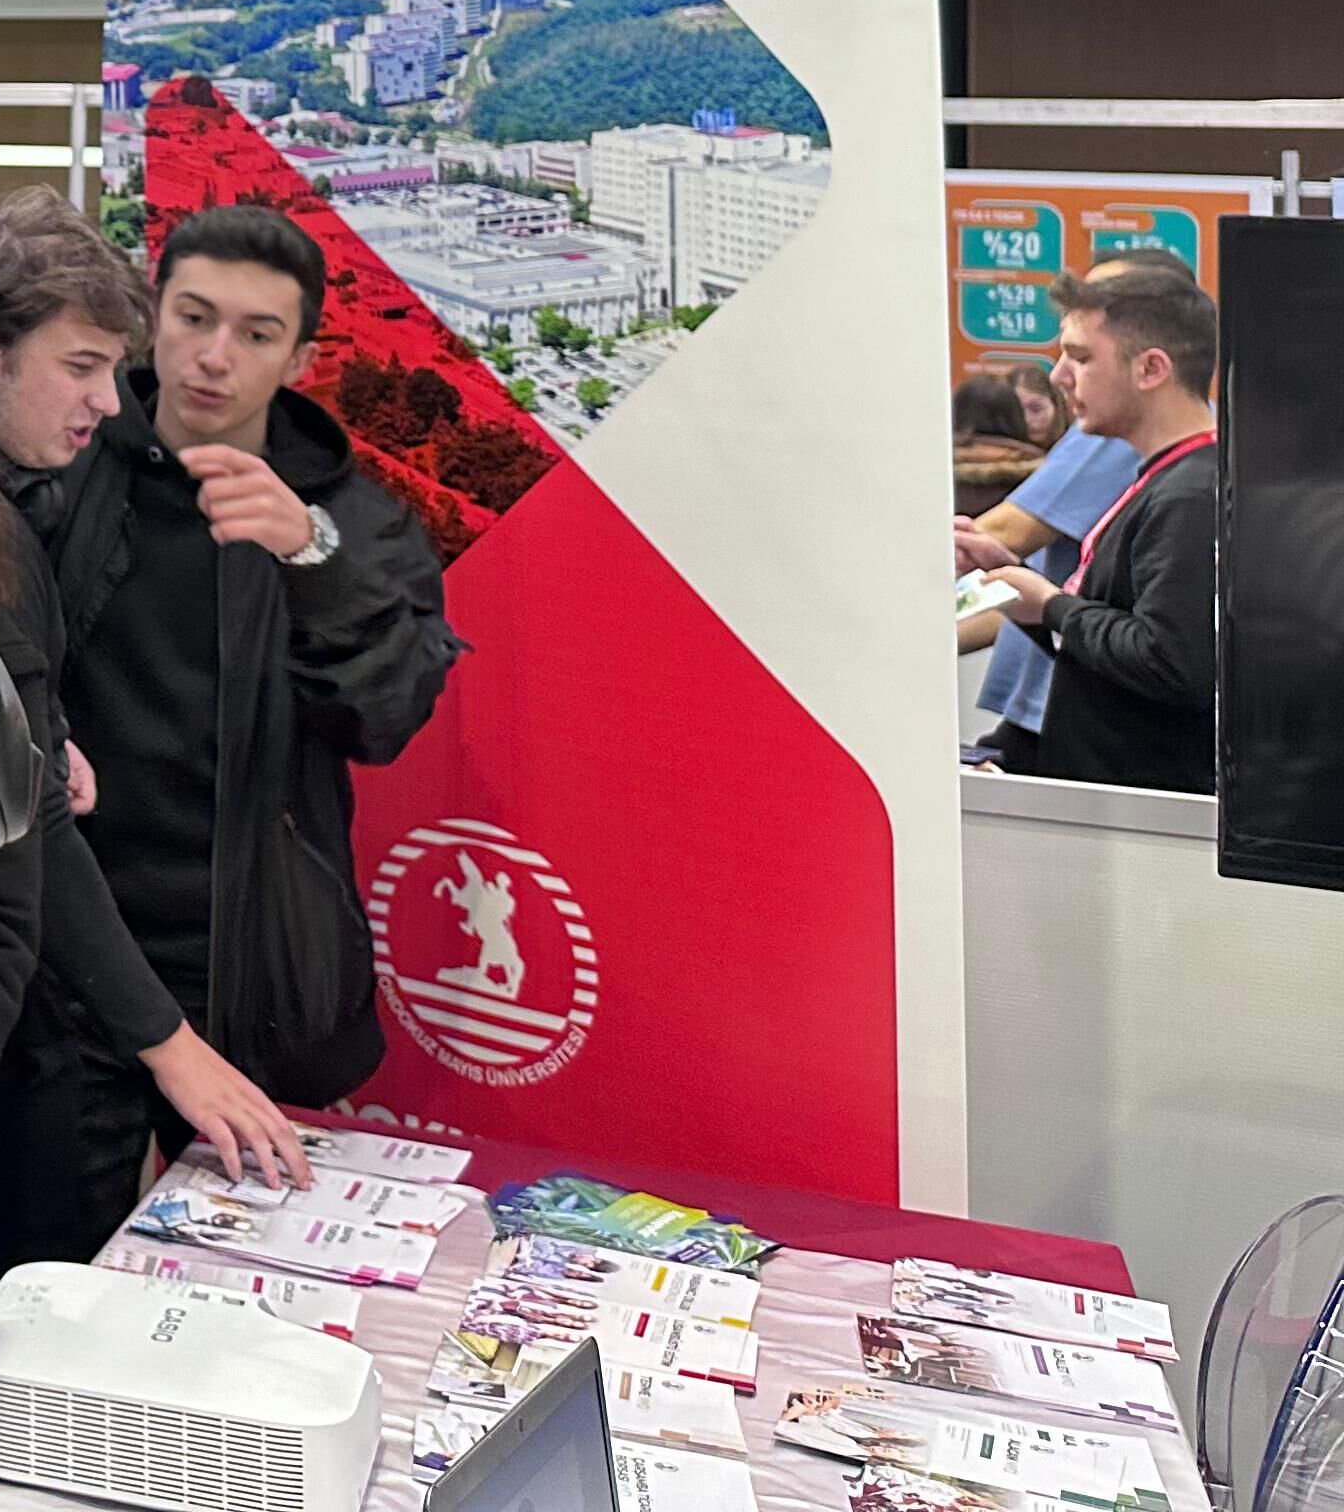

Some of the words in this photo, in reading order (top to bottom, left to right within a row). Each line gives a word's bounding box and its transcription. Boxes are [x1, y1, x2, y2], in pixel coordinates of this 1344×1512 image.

[983, 229, 1040, 260] %20
[485, 1024, 587, 1088] ÜNİVERSİTESİ
[151, 1307, 187, 1344] CASIO
